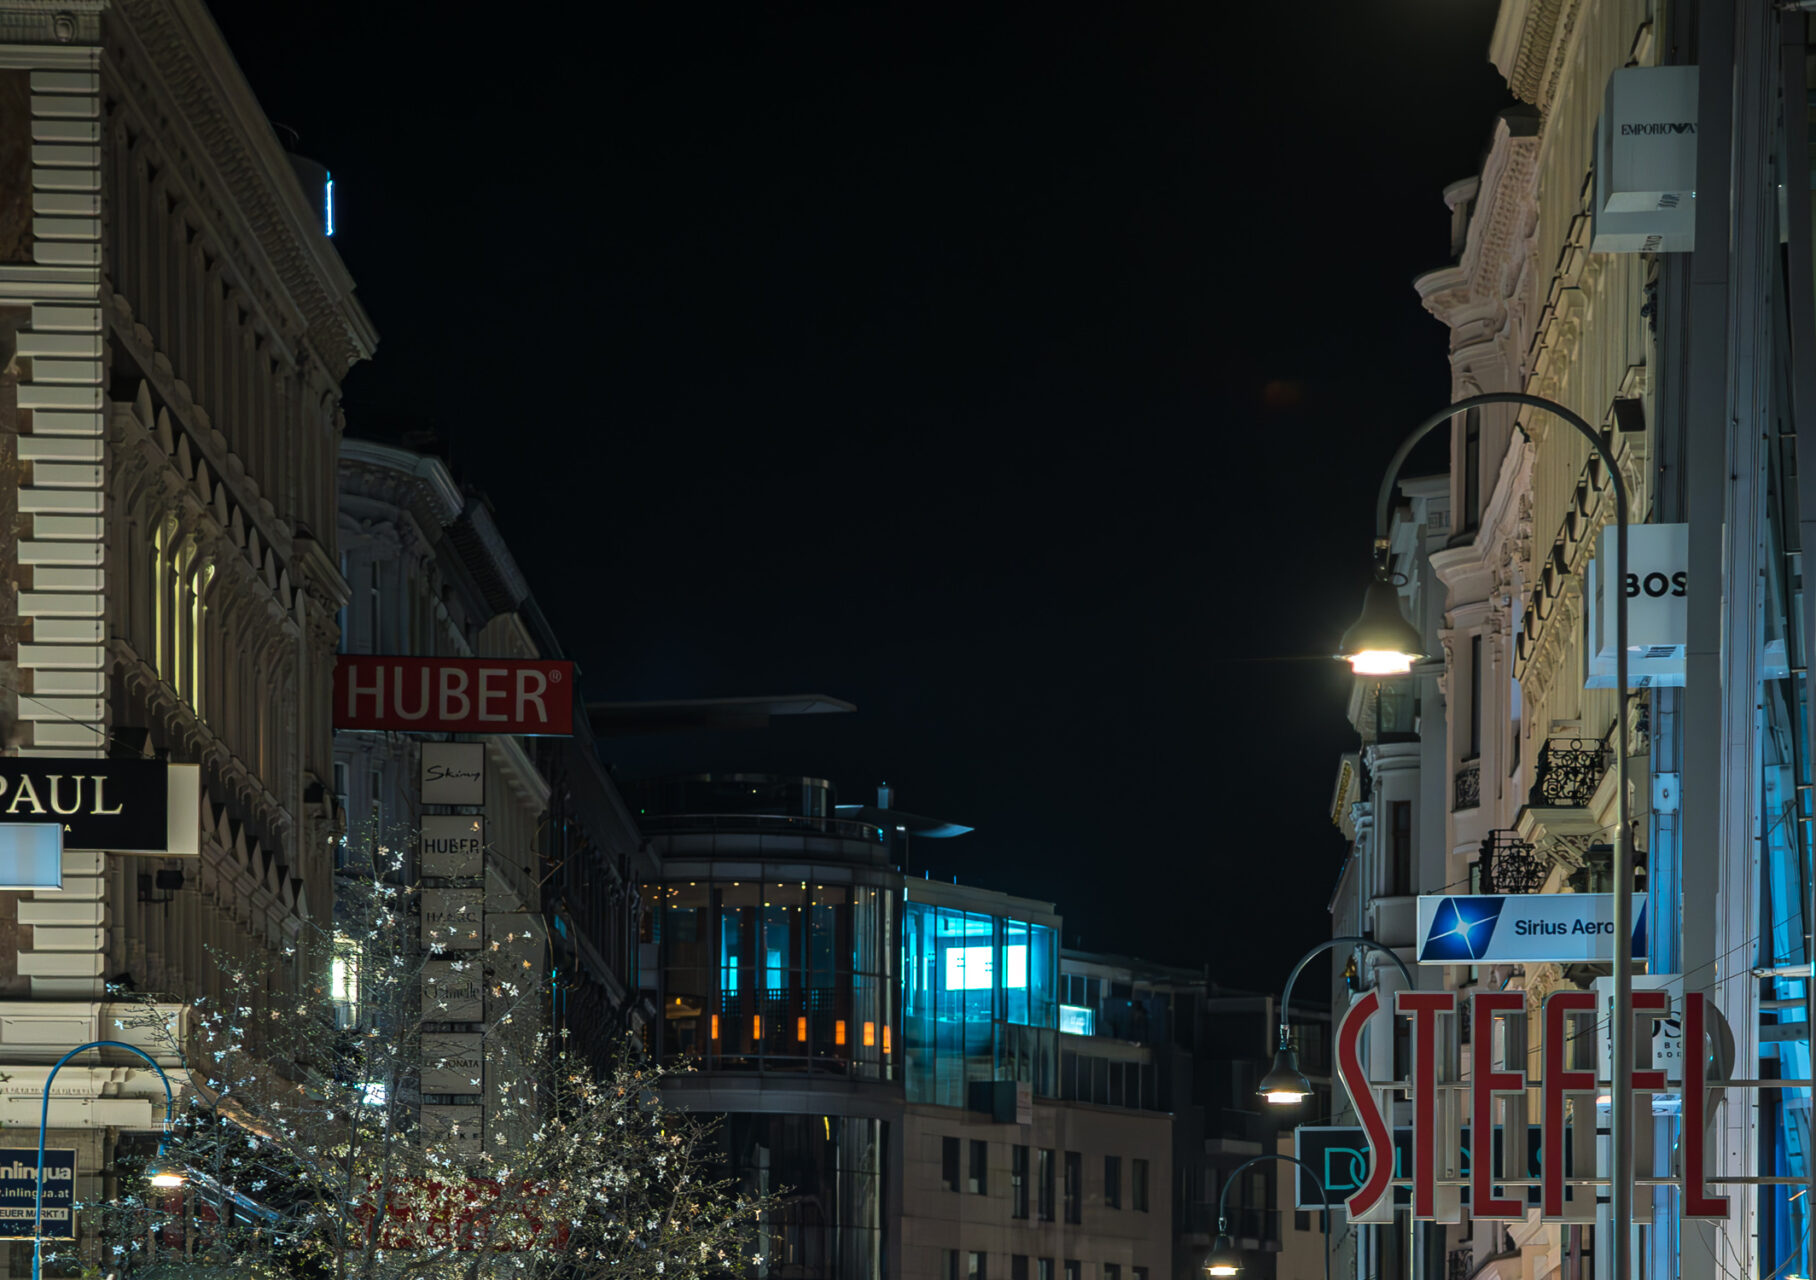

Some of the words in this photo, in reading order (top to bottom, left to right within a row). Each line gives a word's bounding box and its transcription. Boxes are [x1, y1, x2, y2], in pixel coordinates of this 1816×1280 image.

[1621, 123, 1673, 136] EMPORIO
[347, 664, 549, 723] HUBER
[1515, 919, 1567, 936] Sirius
[1571, 918, 1614, 936] Aero
